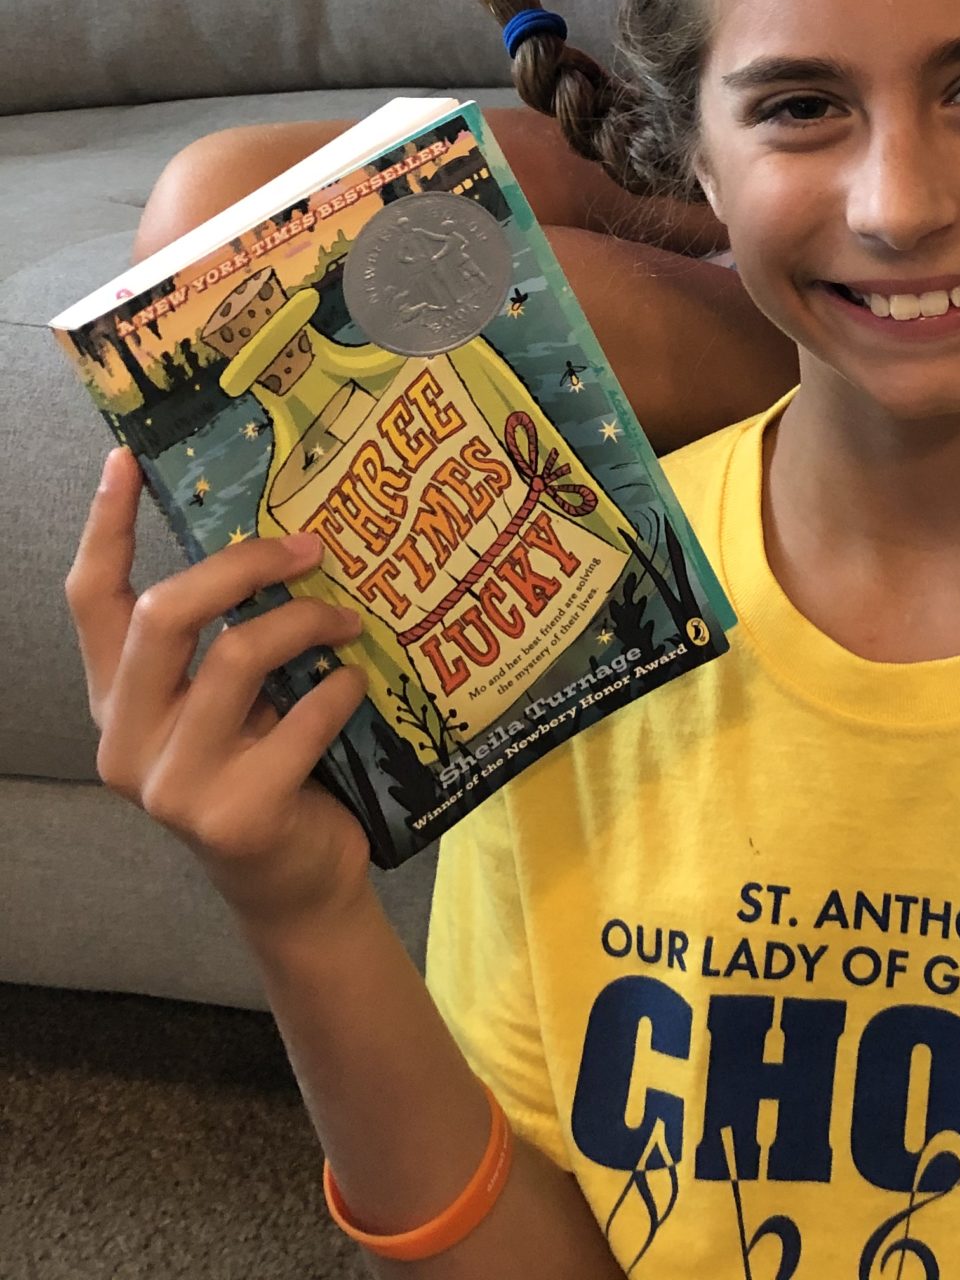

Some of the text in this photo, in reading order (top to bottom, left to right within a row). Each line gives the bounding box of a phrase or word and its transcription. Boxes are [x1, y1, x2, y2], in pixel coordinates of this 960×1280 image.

[116, 140, 449, 338] A NEW YORK TIMES BESTSELLER
[304, 367, 467, 579] THREE
[356, 435, 512, 620] TIMES
[419, 510, 581, 697] LUCKY
[468, 557, 602, 701] Mo and her best friend are solving
[496, 587, 600, 696] the mystery of their lives.
[412, 643, 688, 831] Winner of the Newbery Honor Award
[439, 646, 642, 789] Sheila Turnage
[600, 918, 690, 973] OUR
[701, 936, 829, 983] LADY
[842, 945, 910, 989] OF
[737, 881, 798, 928] ST.
